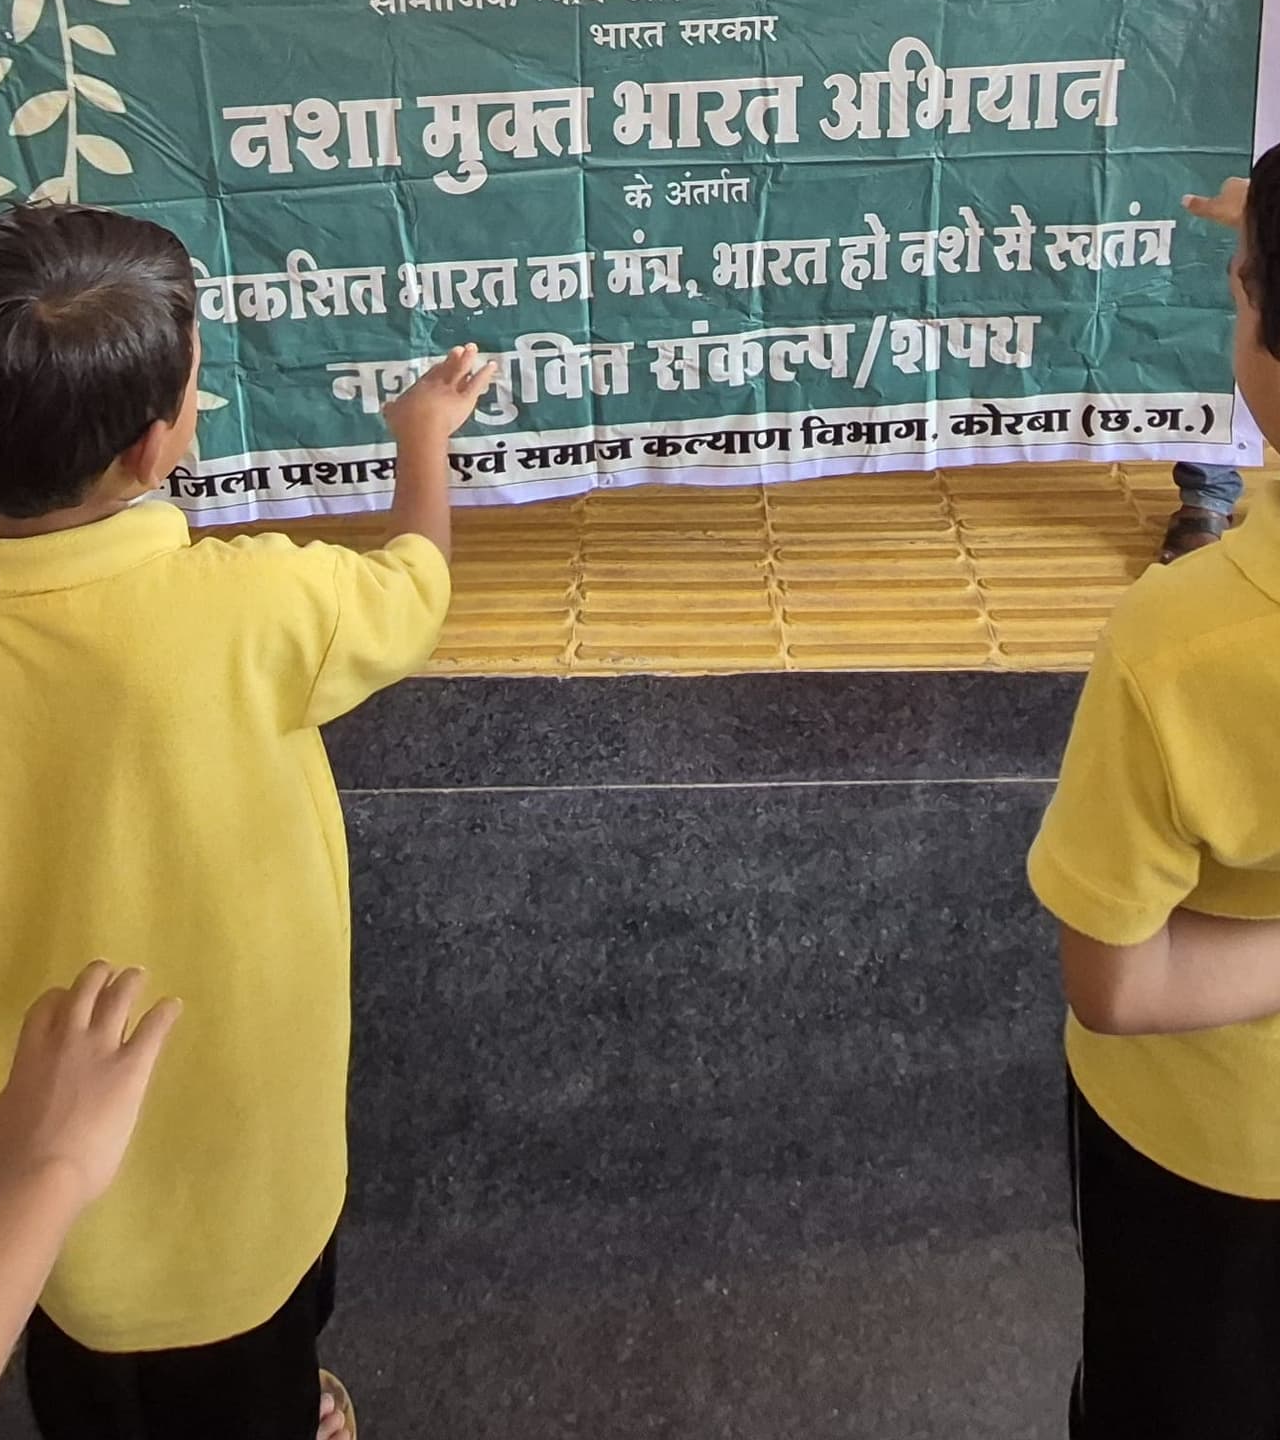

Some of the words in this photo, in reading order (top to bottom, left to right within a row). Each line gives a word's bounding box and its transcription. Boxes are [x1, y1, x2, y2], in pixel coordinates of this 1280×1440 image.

[589, 20, 667, 49] भारत
[678, 15, 779, 43] सरकार
[222, 96, 403, 174] नशा
[415, 86, 595, 195] मुक्त
[612, 74, 804, 150] भारत
[819, 35, 1125, 142] अभियान
[623, 173, 653, 210] के
[664, 168, 751, 206] अंतर्गत
[397, 256, 519, 315] भारत
[527, 249, 595, 303] का
[712, 236, 830, 290] भारत
[838, 211, 890, 291] हो
[898, 206, 985, 276] नशे
[992, 204, 1033, 272] से
[1044, 200, 1177, 271] स्वतंत्र
[160, 465, 270, 499] जिला
[278, 456, 398, 491] प्रशास
[447, 440, 508, 482] एवं
[515, 434, 633, 474] समाज
[641, 425, 791, 461] कल्याण
[949, 402, 1071, 436] कोरबा
[1081, 402, 1216, 438] (छ.ग.)
